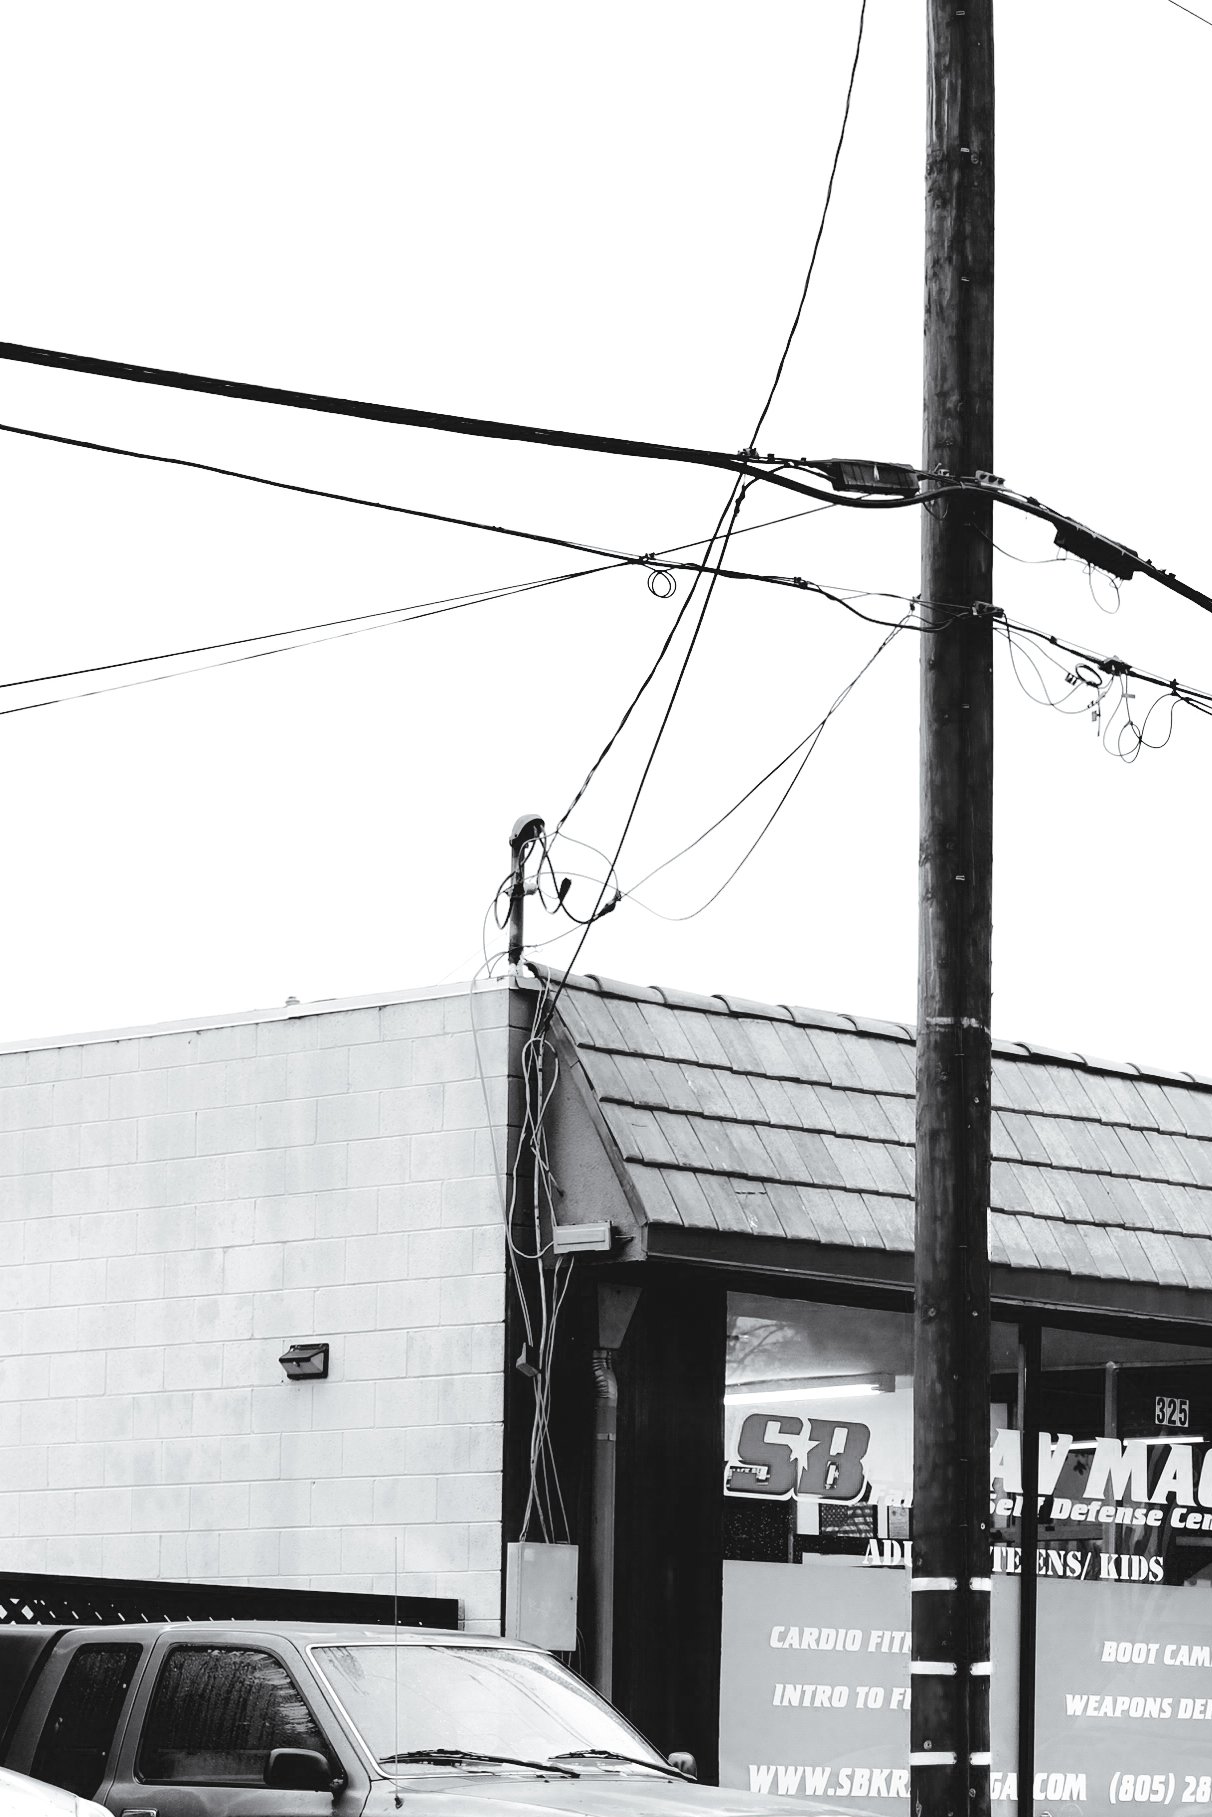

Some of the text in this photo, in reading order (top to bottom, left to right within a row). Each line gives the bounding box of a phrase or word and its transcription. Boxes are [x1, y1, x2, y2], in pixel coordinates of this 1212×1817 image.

[1156, 1397, 1189, 1427] 325
[725, 1412, 873, 1504] SB
[1049, 1497, 1163, 1527] Defense
[1099, 1552, 1165, 1582] KIDS
[769, 1626, 863, 1652] CARDIO
[1101, 1641, 1160, 1665] BOOT
[772, 1683, 849, 1708] INTRO
[855, 1686, 885, 1709] TO
[1065, 1694, 1174, 1719] WEAPONS
[1109, 1771, 1176, 1804] (805)
